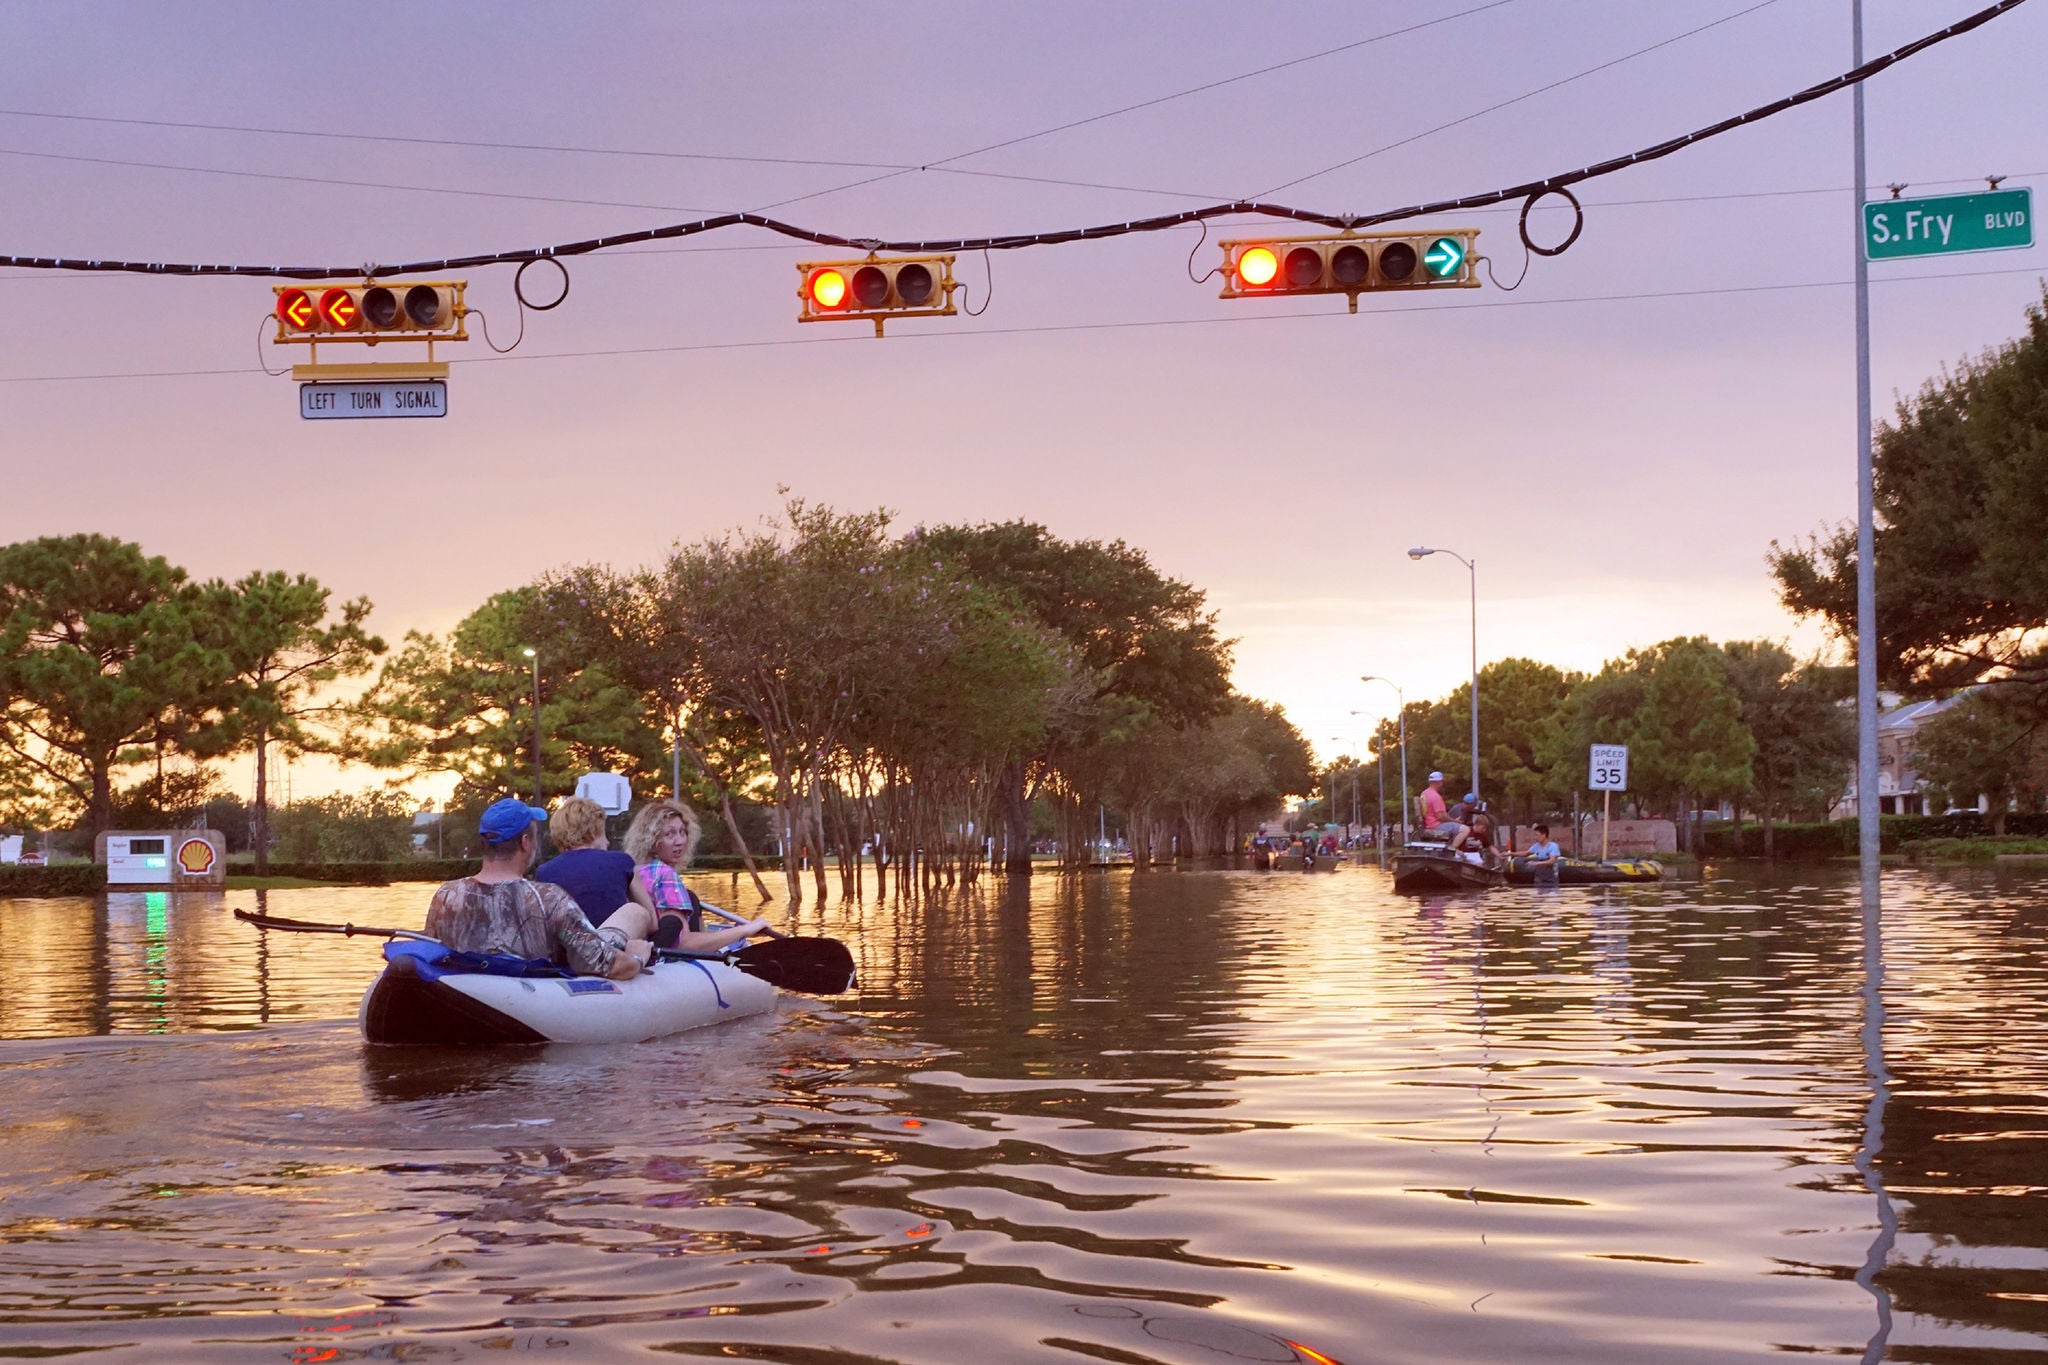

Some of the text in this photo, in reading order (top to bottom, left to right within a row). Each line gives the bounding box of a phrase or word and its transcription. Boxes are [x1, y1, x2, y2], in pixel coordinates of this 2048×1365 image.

[1984, 211, 2025, 230] BLVD
[308, 391, 438, 409] LEFT TURN SIGNAL
[1594, 750, 1625, 758] SPEED
[1595, 768, 1621, 784] 35
